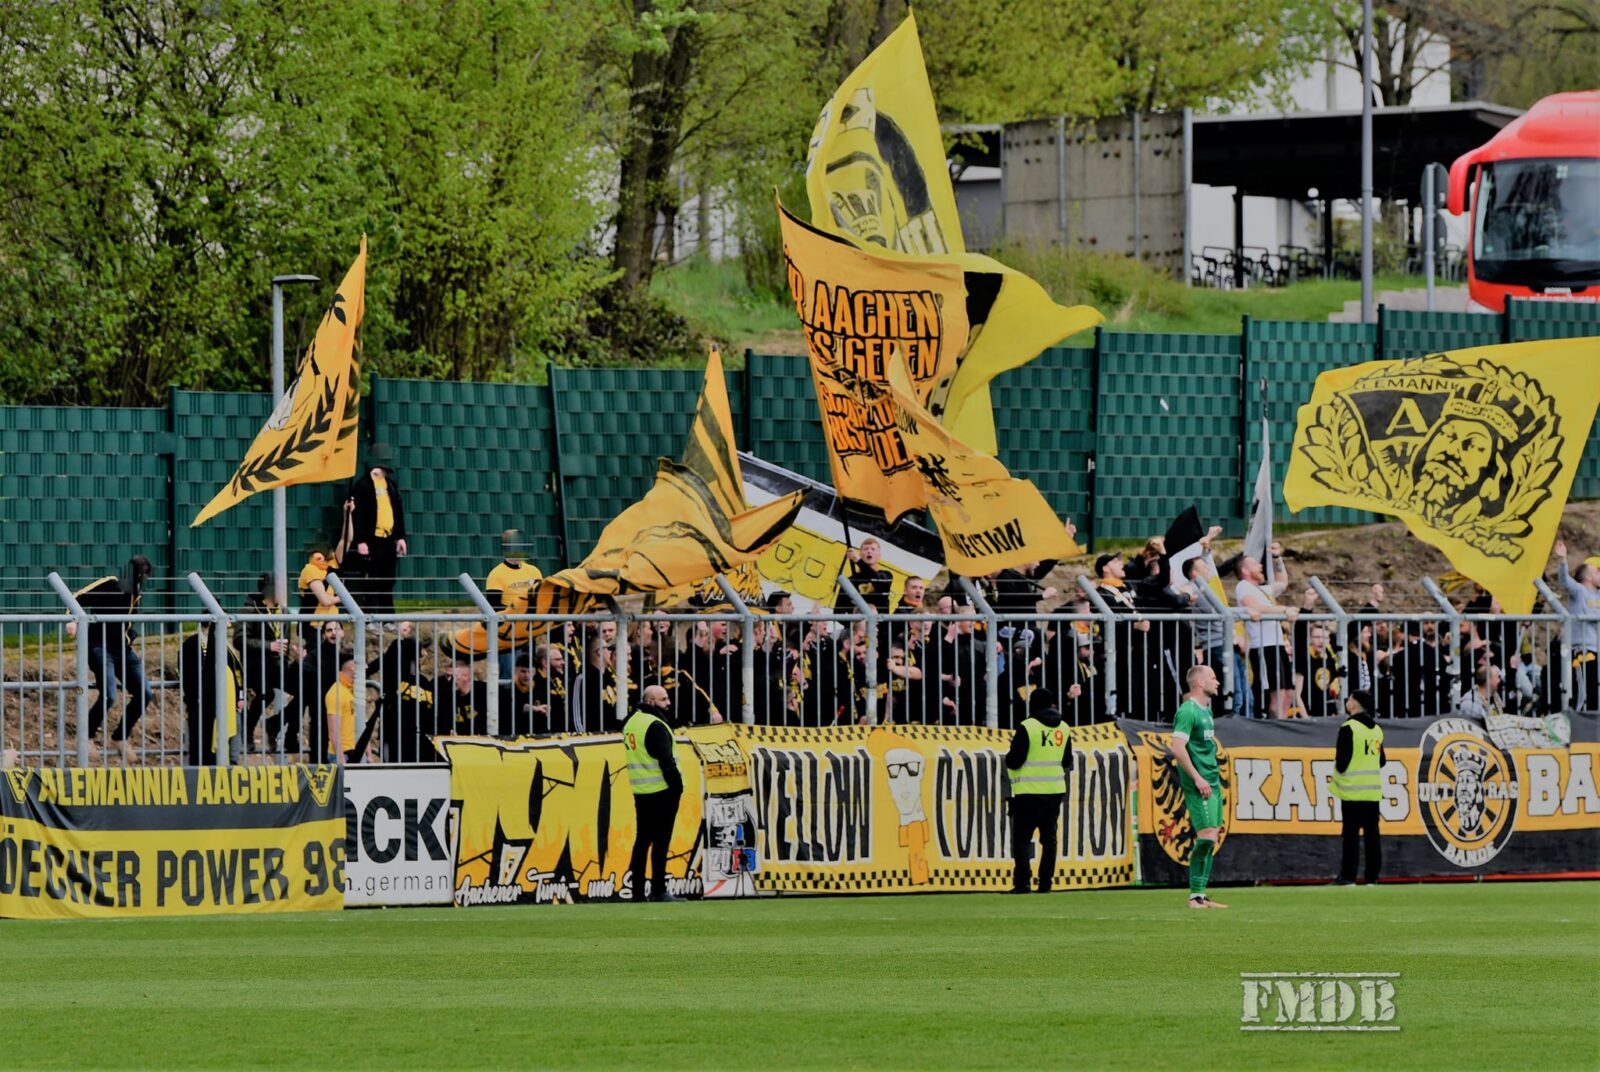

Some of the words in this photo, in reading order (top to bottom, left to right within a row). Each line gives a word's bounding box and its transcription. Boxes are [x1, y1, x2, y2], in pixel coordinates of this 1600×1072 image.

[812, 280, 940, 339] AACHEN
[1385, 397, 1429, 435] A
[1041, 730, 1064, 747] K9
[38, 768, 188, 807] ALEMANNIA
[196, 767, 300, 804] AACHEN
[752, 746, 871, 862] YELLOW
[1234, 757, 1409, 823] KARS
[0, 824, 140, 908] ÖECHER
[157, 848, 290, 908] POWER
[303, 839, 344, 897] 98
[1446, 840, 1498, 866] BANDE
[455, 875, 521, 907] Aachener
[527, 868, 579, 903] Turn-
[588, 872, 615, 898] und
